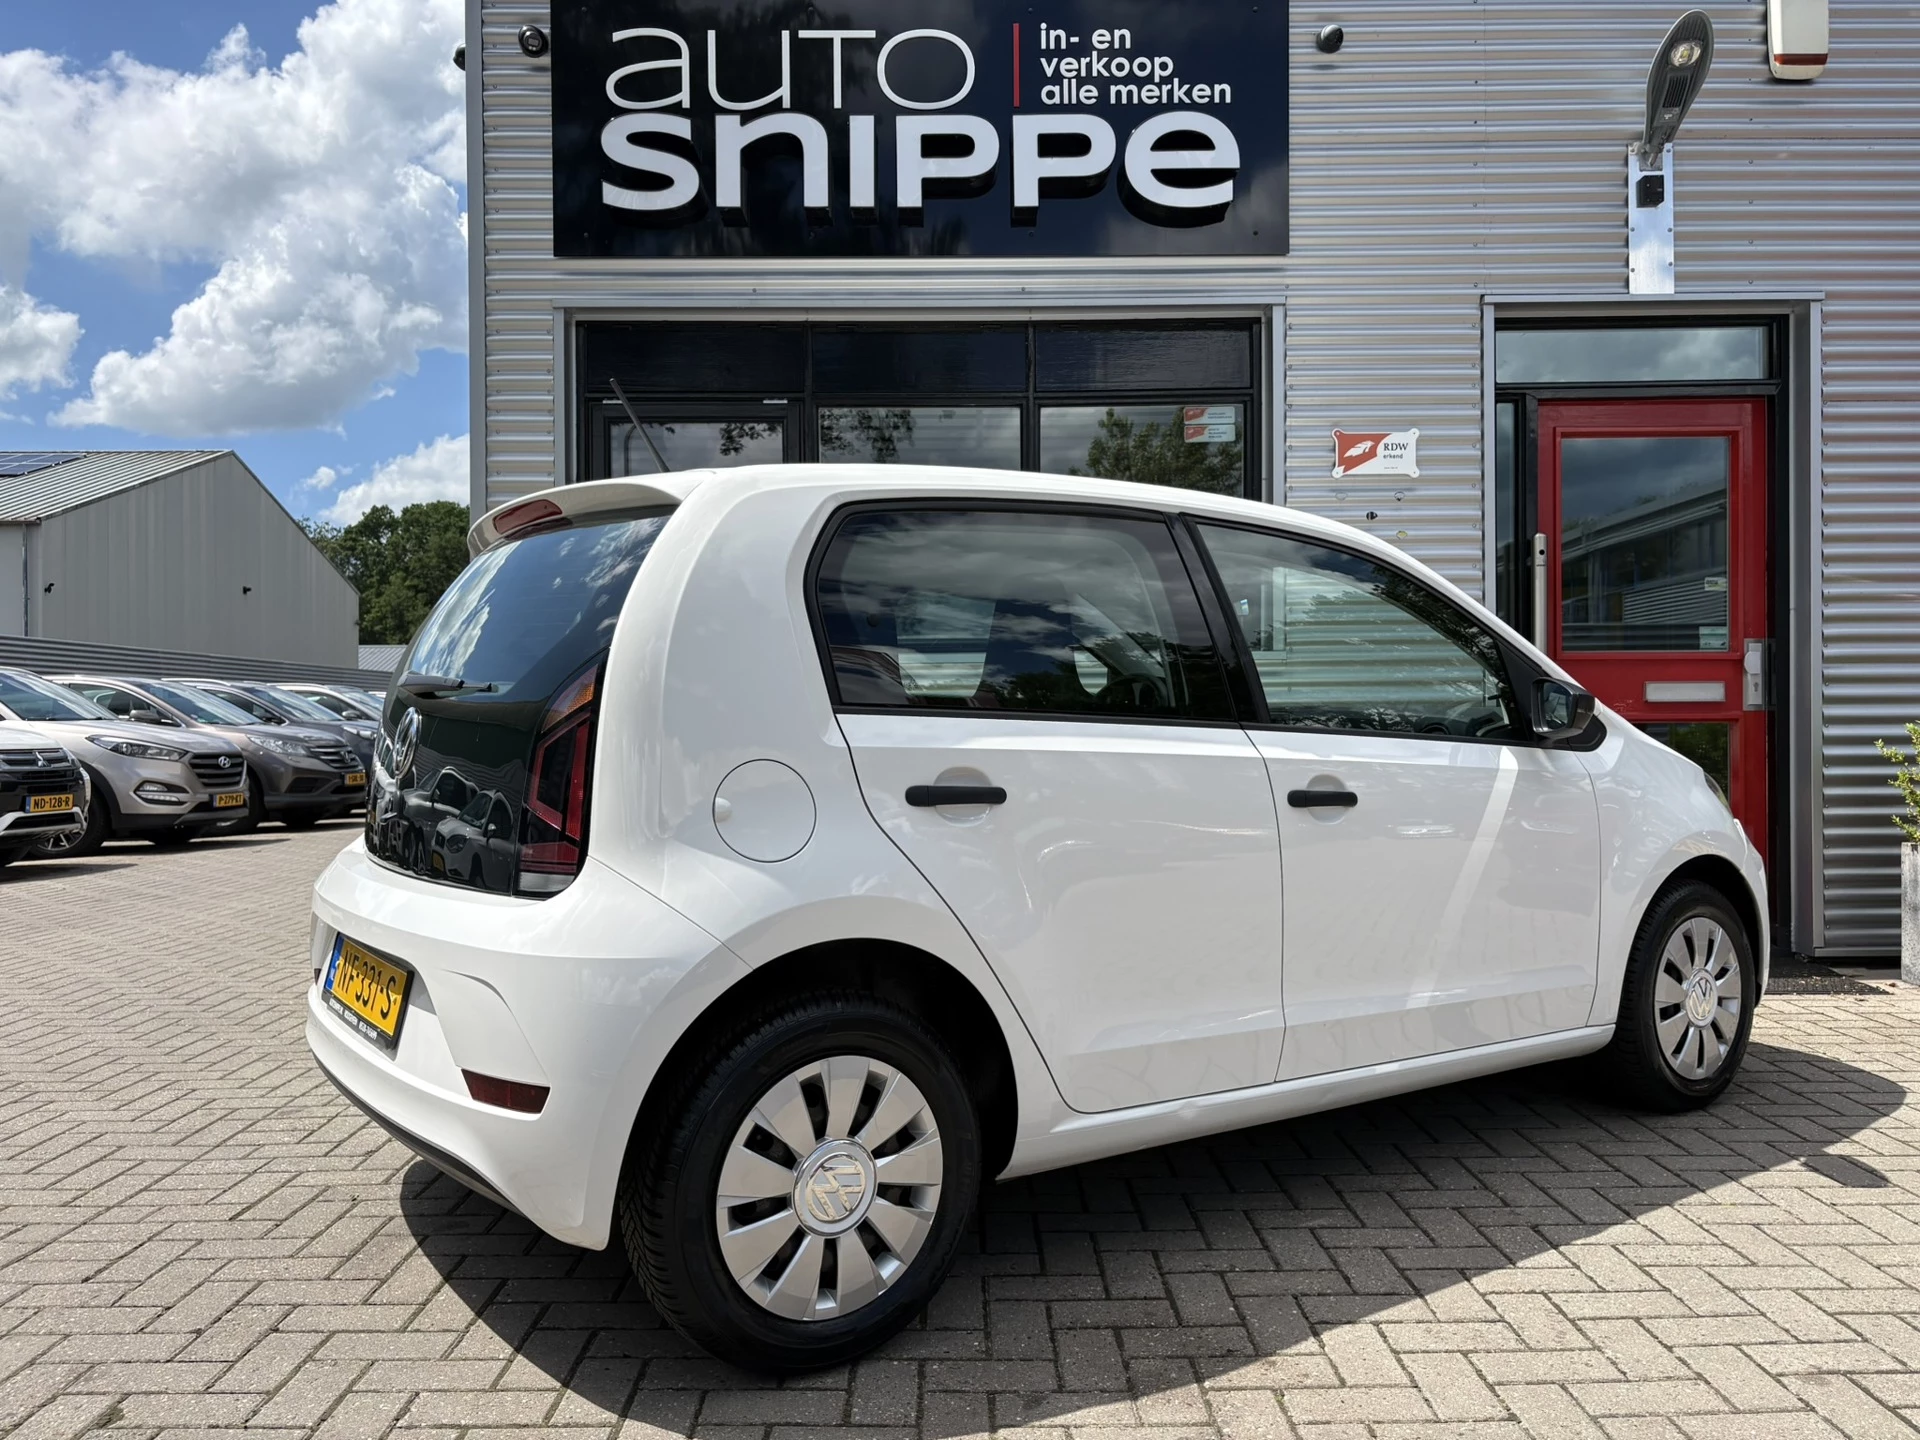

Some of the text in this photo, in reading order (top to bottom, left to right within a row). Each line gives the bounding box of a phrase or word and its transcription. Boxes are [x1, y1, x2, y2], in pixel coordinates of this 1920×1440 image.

[1040, 22, 1131, 50] in- en
[1040, 51, 1174, 83] verkoop
[1040, 77, 1231, 105] alle merken
[1383, 442, 1409, 452] RDW
[33, 796, 70, 810] ND-128-R
